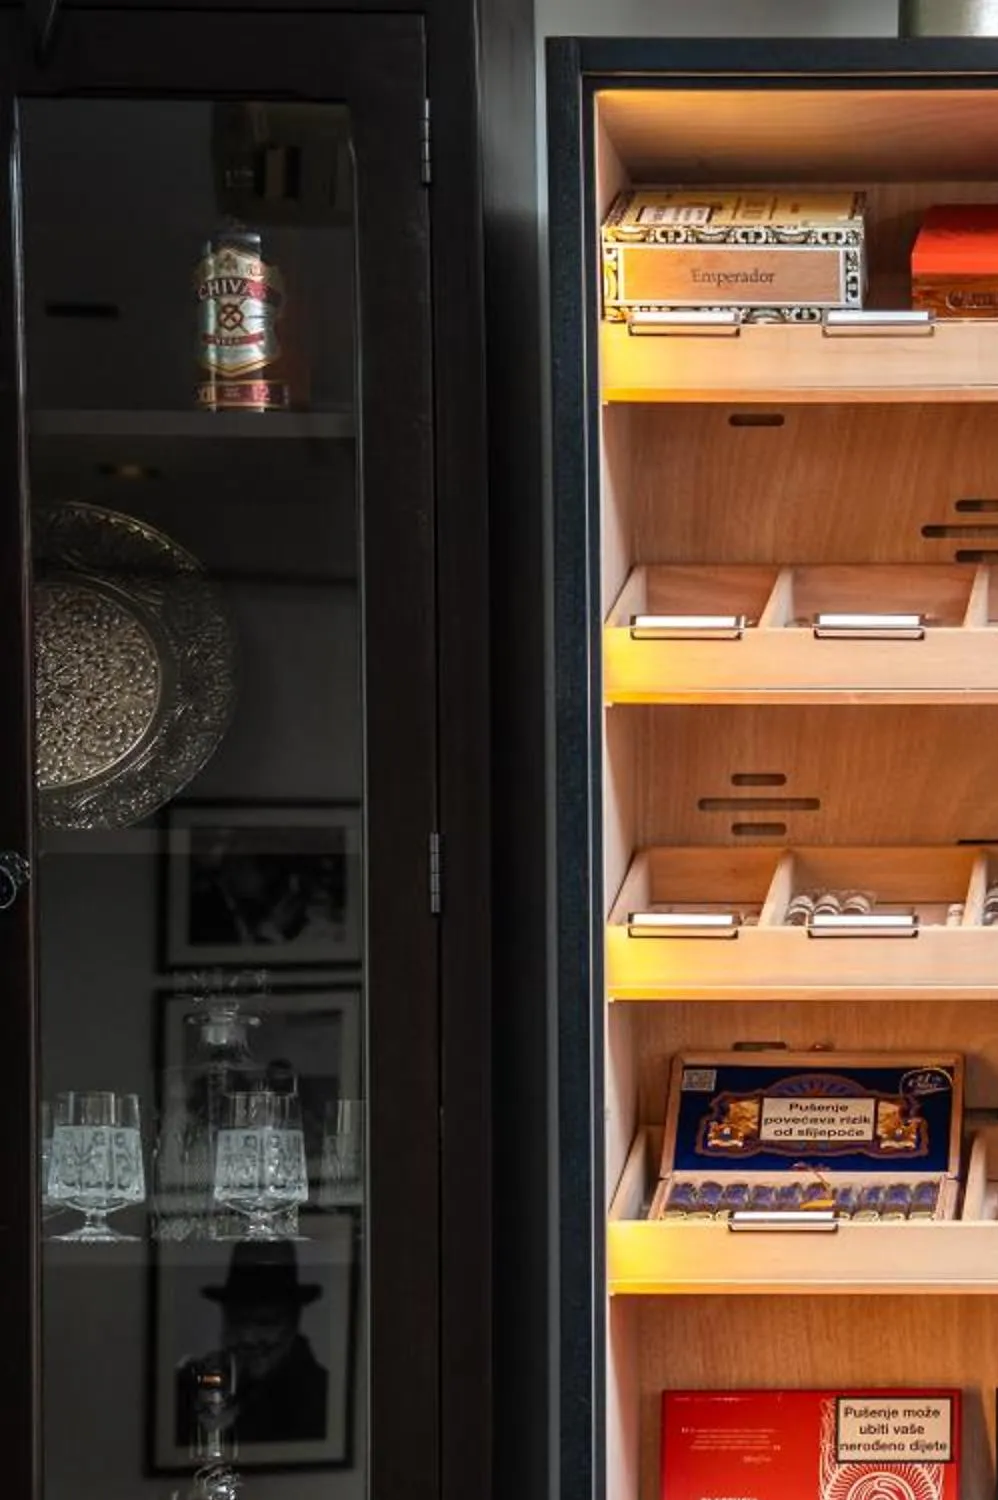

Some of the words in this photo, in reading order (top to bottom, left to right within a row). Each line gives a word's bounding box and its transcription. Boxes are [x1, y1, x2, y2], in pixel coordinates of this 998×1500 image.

[691, 268, 776, 288] Emperador
[199, 277, 265, 299] CHIVA
[839, 1115, 871, 1125] rizik
[773, 1127, 793, 1137] od
[843, 1406, 899, 1420] Pušenje
[903, 1405, 941, 1418] može
[859, 1423, 889, 1435] ubiti
[893, 1423, 925, 1435] vaše
[909, 1440, 948, 1453] dijete
